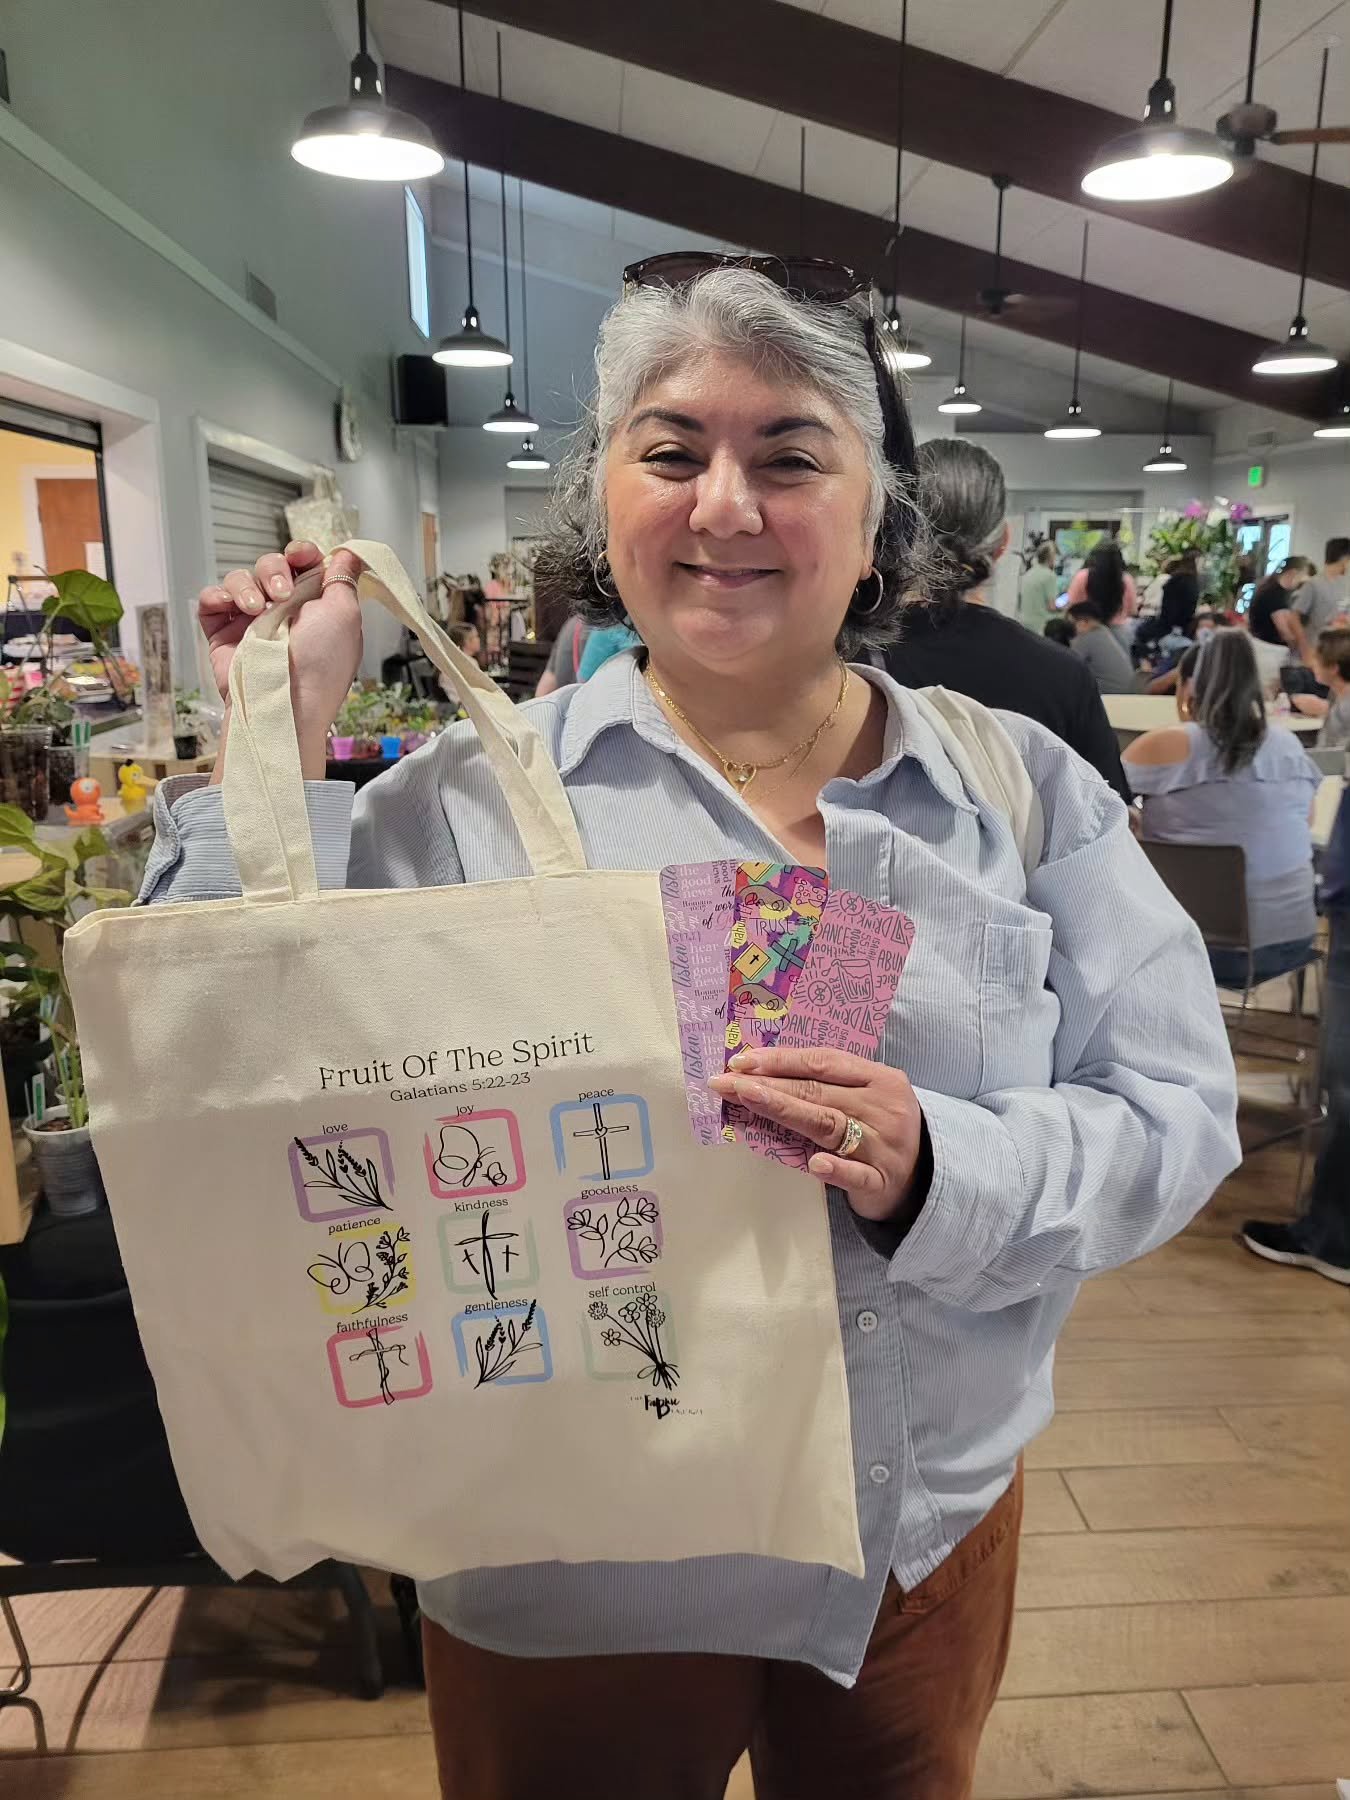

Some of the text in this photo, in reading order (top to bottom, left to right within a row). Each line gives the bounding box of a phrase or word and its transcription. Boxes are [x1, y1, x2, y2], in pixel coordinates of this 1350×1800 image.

[681, 873, 712, 890] good
[682, 888, 713, 898] news
[715, 902, 734, 912] wor
[702, 912, 714, 930] of
[749, 918, 794, 936] TRUST
[814, 922, 852, 948] DANCE
[689, 941, 718, 954] hear
[692, 953, 712, 965] the
[694, 962, 724, 980] good
[694, 976, 726, 988] news
[714, 1001, 726, 1019] of
[782, 1014, 820, 1040] DANCE
[702, 1032, 724, 1044] hea
[319, 1032, 596, 1090] Fruit Of The Spirit
[390, 1072, 532, 1102] Galatians 5:22-23
[578, 1087, 615, 1102] peace
[322, 1121, 348, 1134] love
[580, 1183, 639, 1200] goodness
[454, 1197, 510, 1212] kindness
[328, 1216, 382, 1236] patience
[588, 1281, 656, 1298] self control
[464, 1297, 529, 1316] gentleness
[336, 1312, 409, 1335] faithfulness
